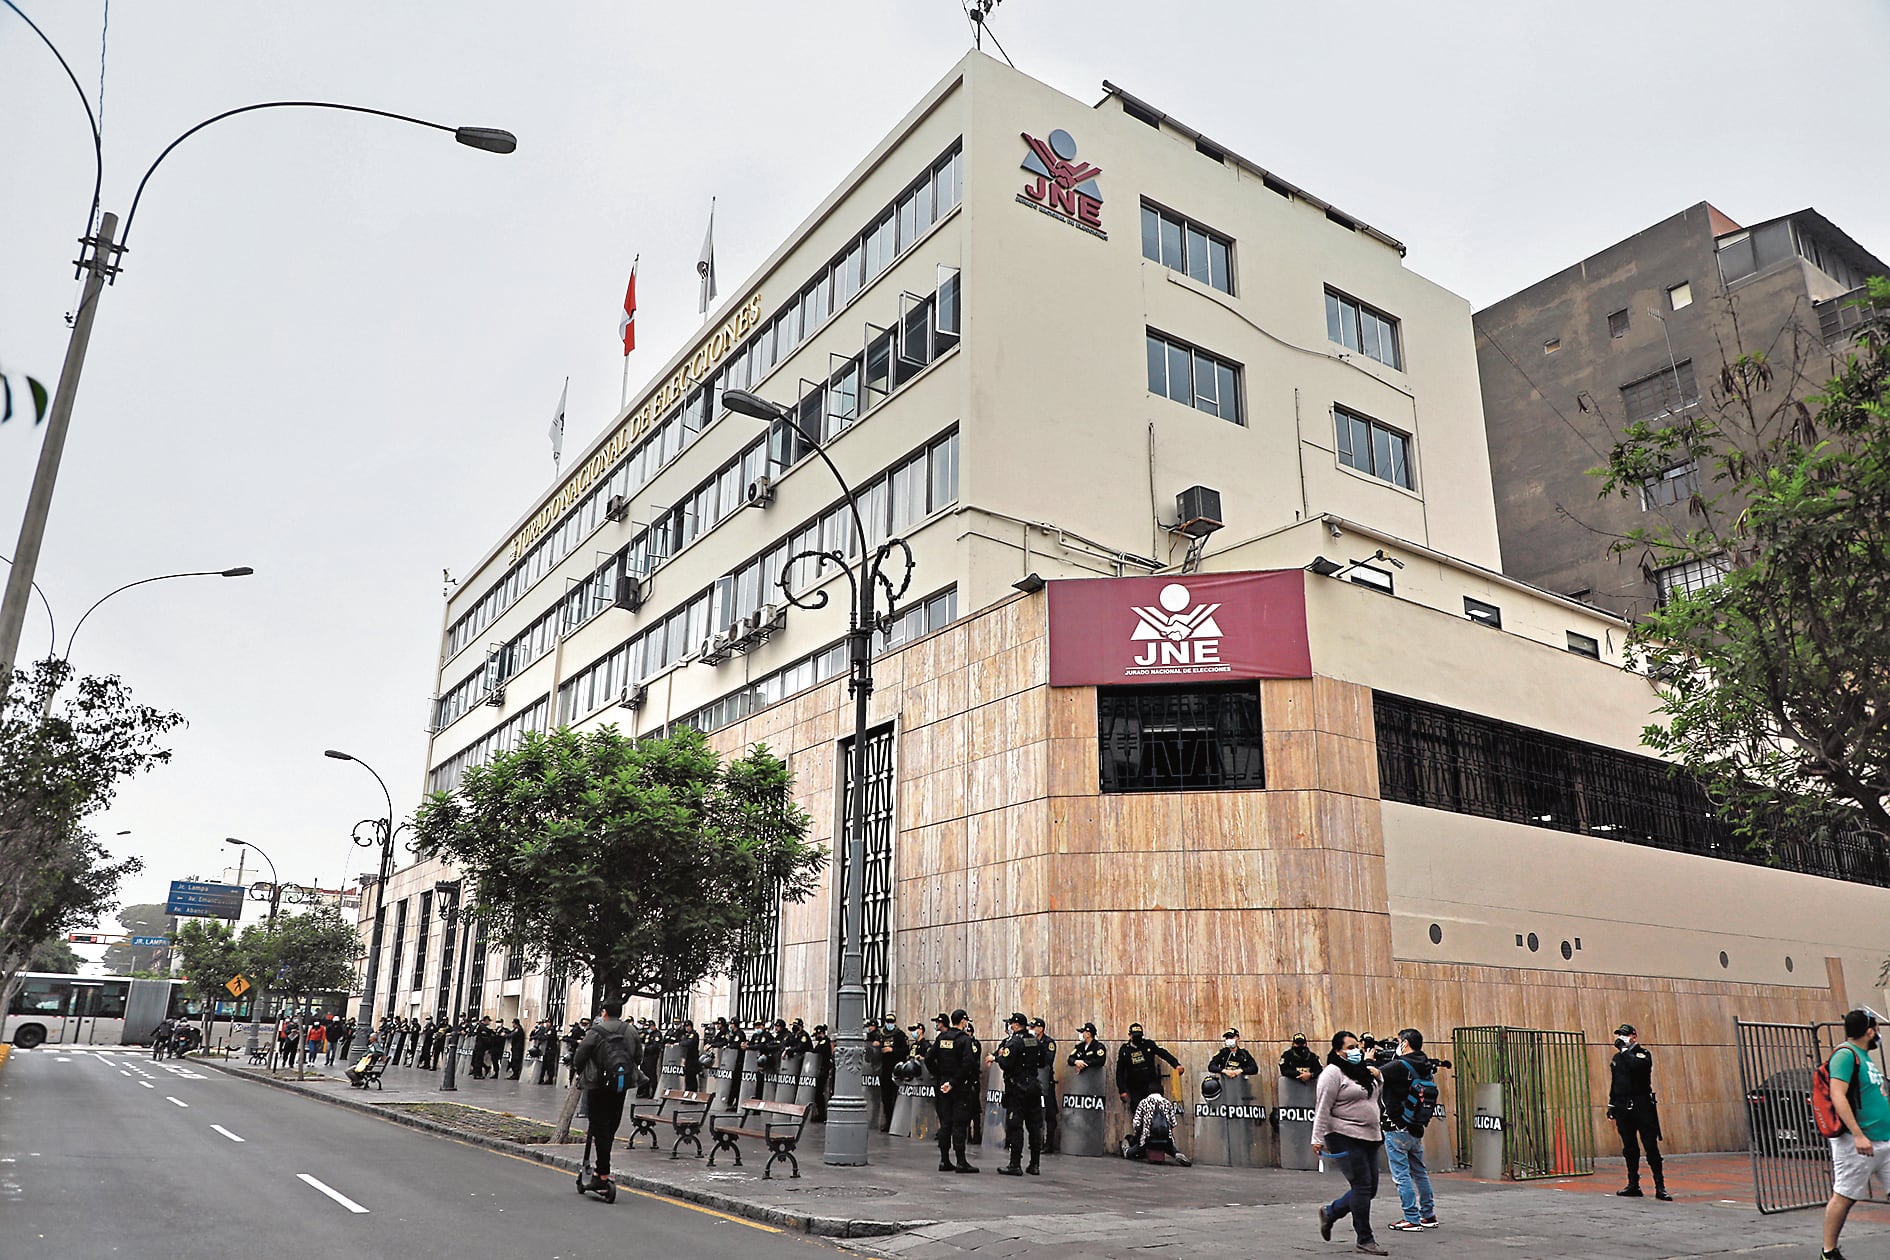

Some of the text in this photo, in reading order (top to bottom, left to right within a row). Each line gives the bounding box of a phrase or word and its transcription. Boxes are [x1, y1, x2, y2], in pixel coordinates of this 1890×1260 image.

[1025, 175, 1101, 227] JNE
[516, 293, 763, 558] JURADO NACIONAL DE ELECCIONES
[1133, 640, 1221, 666] JNE
[1193, 666, 1232, 674] ELECCIONES
[862, 1076, 880, 1086] LICIA
[1196, 1104, 1227, 1117] POLIC
[1229, 1106, 1265, 1119] POLICIA
[1280, 1108, 1315, 1121] POLIC
